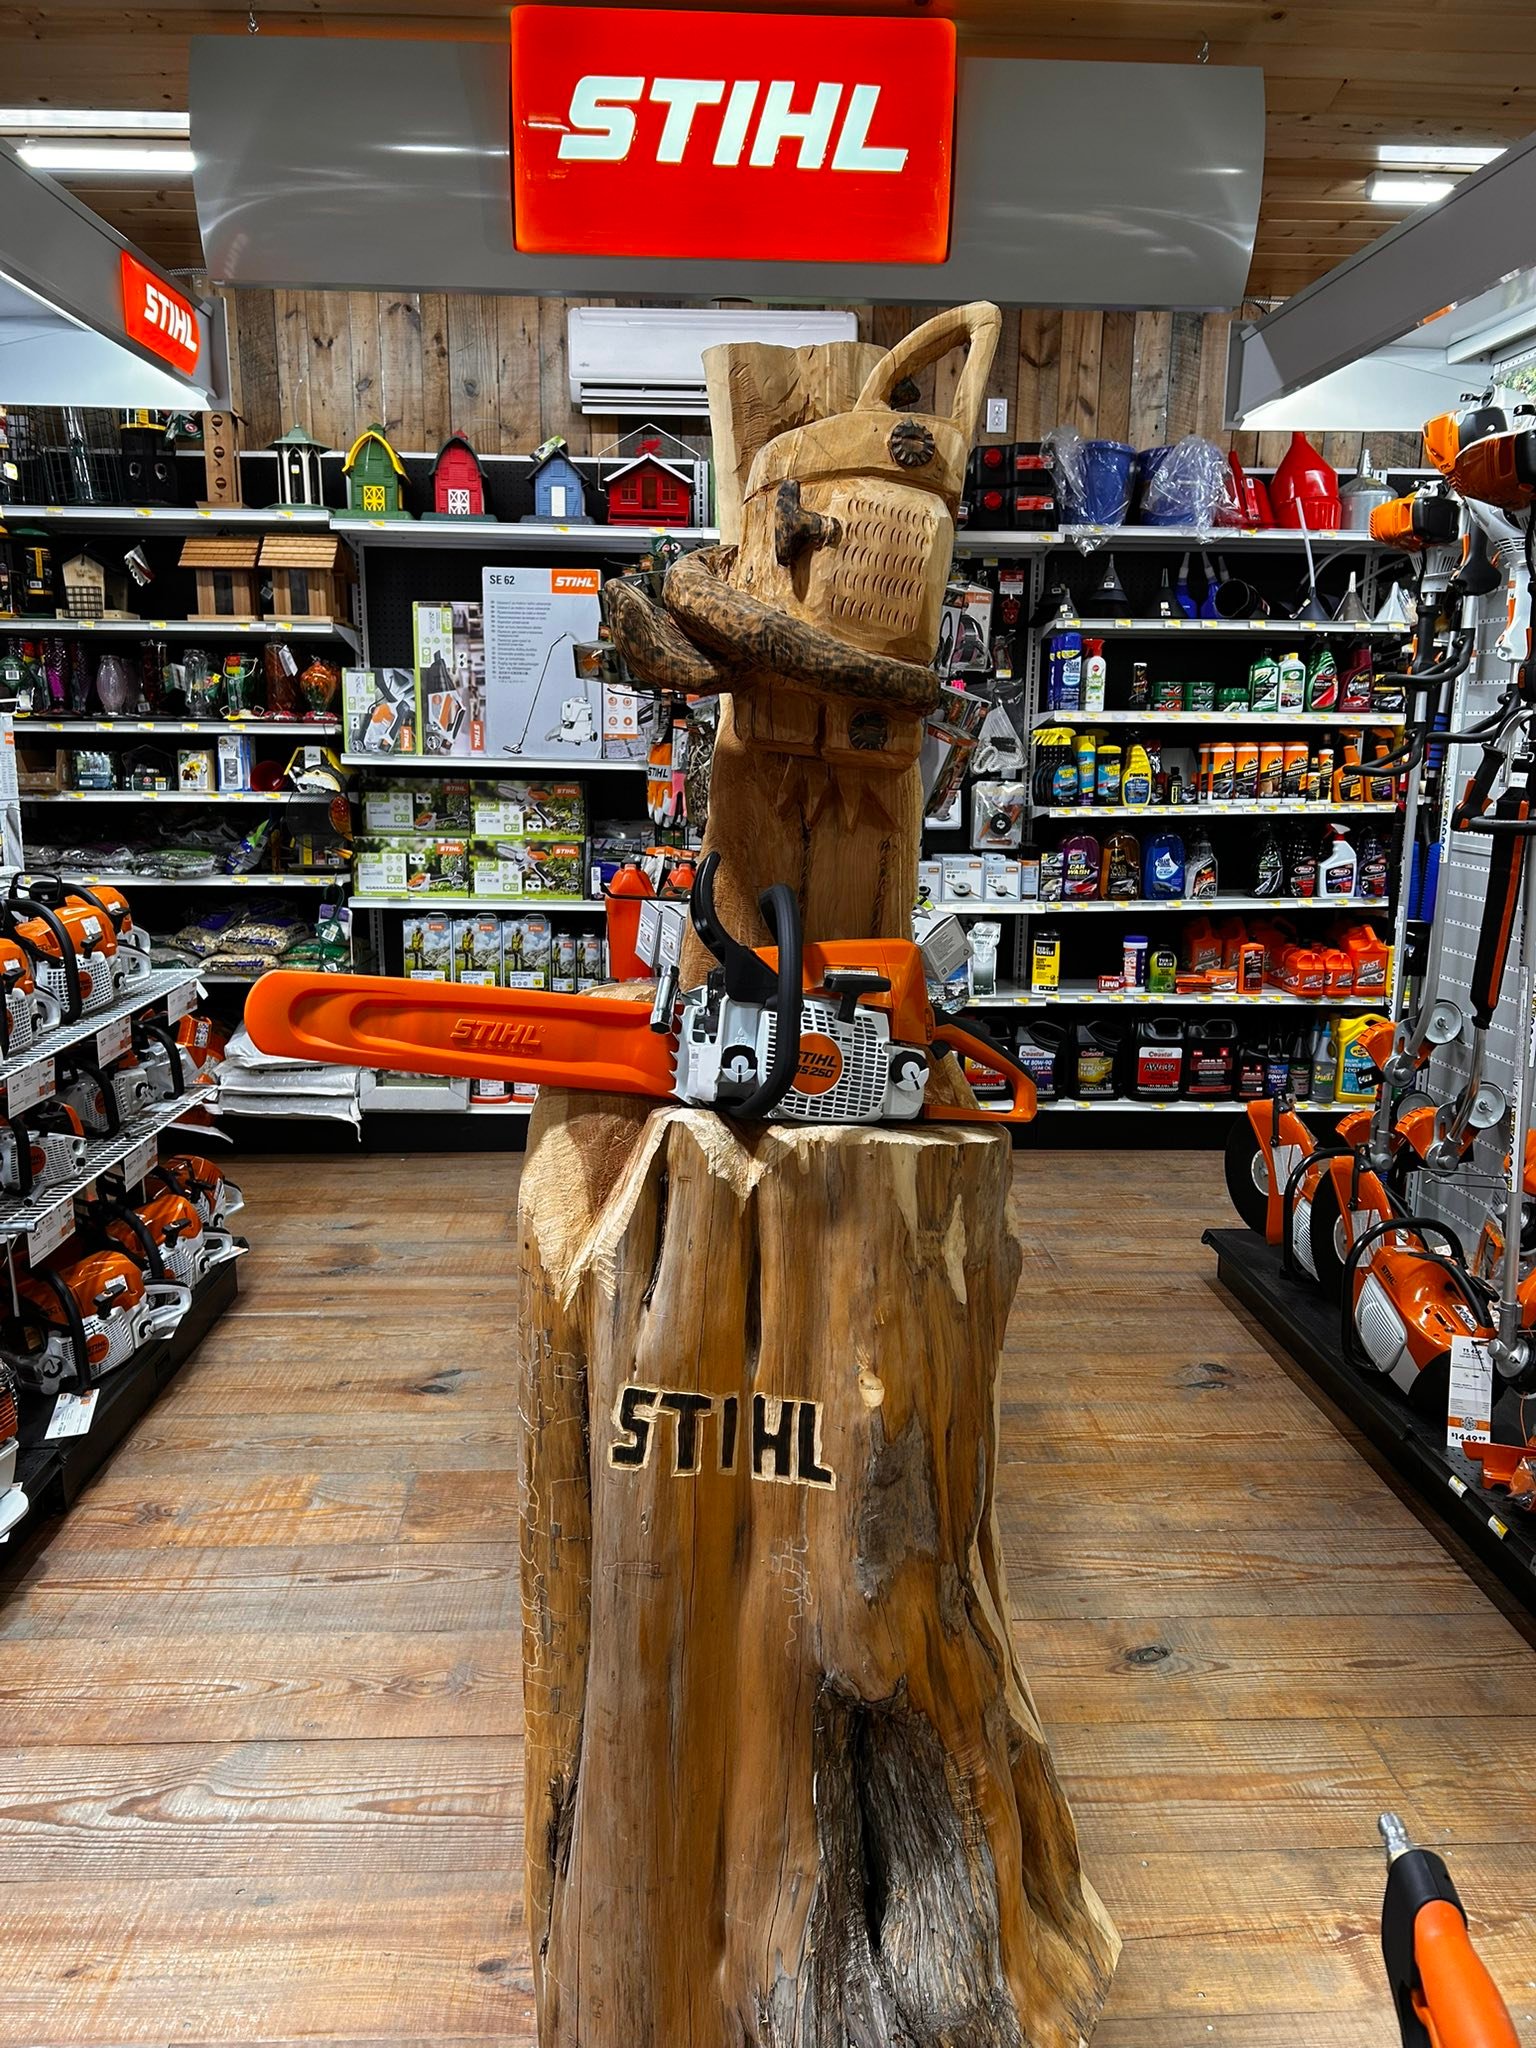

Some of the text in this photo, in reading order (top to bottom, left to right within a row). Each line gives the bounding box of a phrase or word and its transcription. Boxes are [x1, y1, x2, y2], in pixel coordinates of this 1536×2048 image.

[558, 75, 909, 172] STIHL
[144, 283, 198, 353] STIHL
[489, 575, 515, 585] SE 62
[555, 576, 595, 588] STIHL
[403, 728, 411, 749] STIHL
[473, 723, 481, 748] STIHL
[1101, 979, 1120, 988] Lava
[450, 1018, 541, 1046] STIHL
[799, 1051, 837, 1067] TIHL
[809, 1066, 835, 1078] 250
[1381, 1264, 1395, 1286] STIHL
[609, 1385, 837, 1490] STIHL
